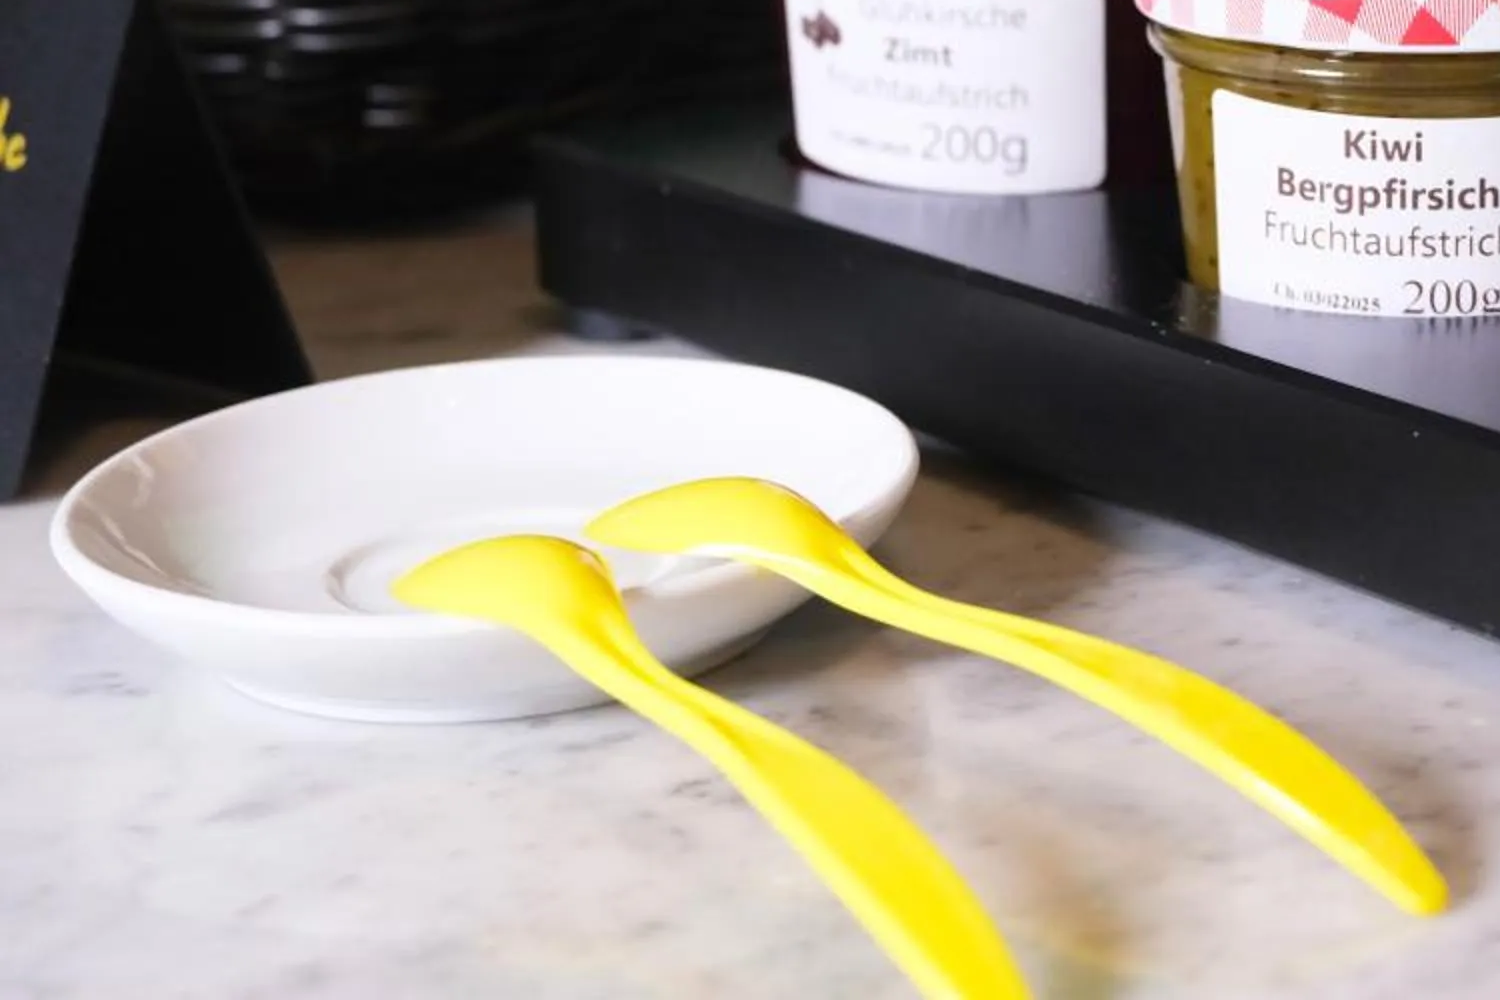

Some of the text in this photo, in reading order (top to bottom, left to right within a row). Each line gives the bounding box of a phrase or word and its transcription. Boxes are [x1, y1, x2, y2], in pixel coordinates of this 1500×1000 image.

[883, 35, 955, 68] Zimt
[919, 121, 1030, 177] 200g
[1342, 128, 1425, 163] Kiwi
[1276, 166, 1500, 216] Bergpfirsich
